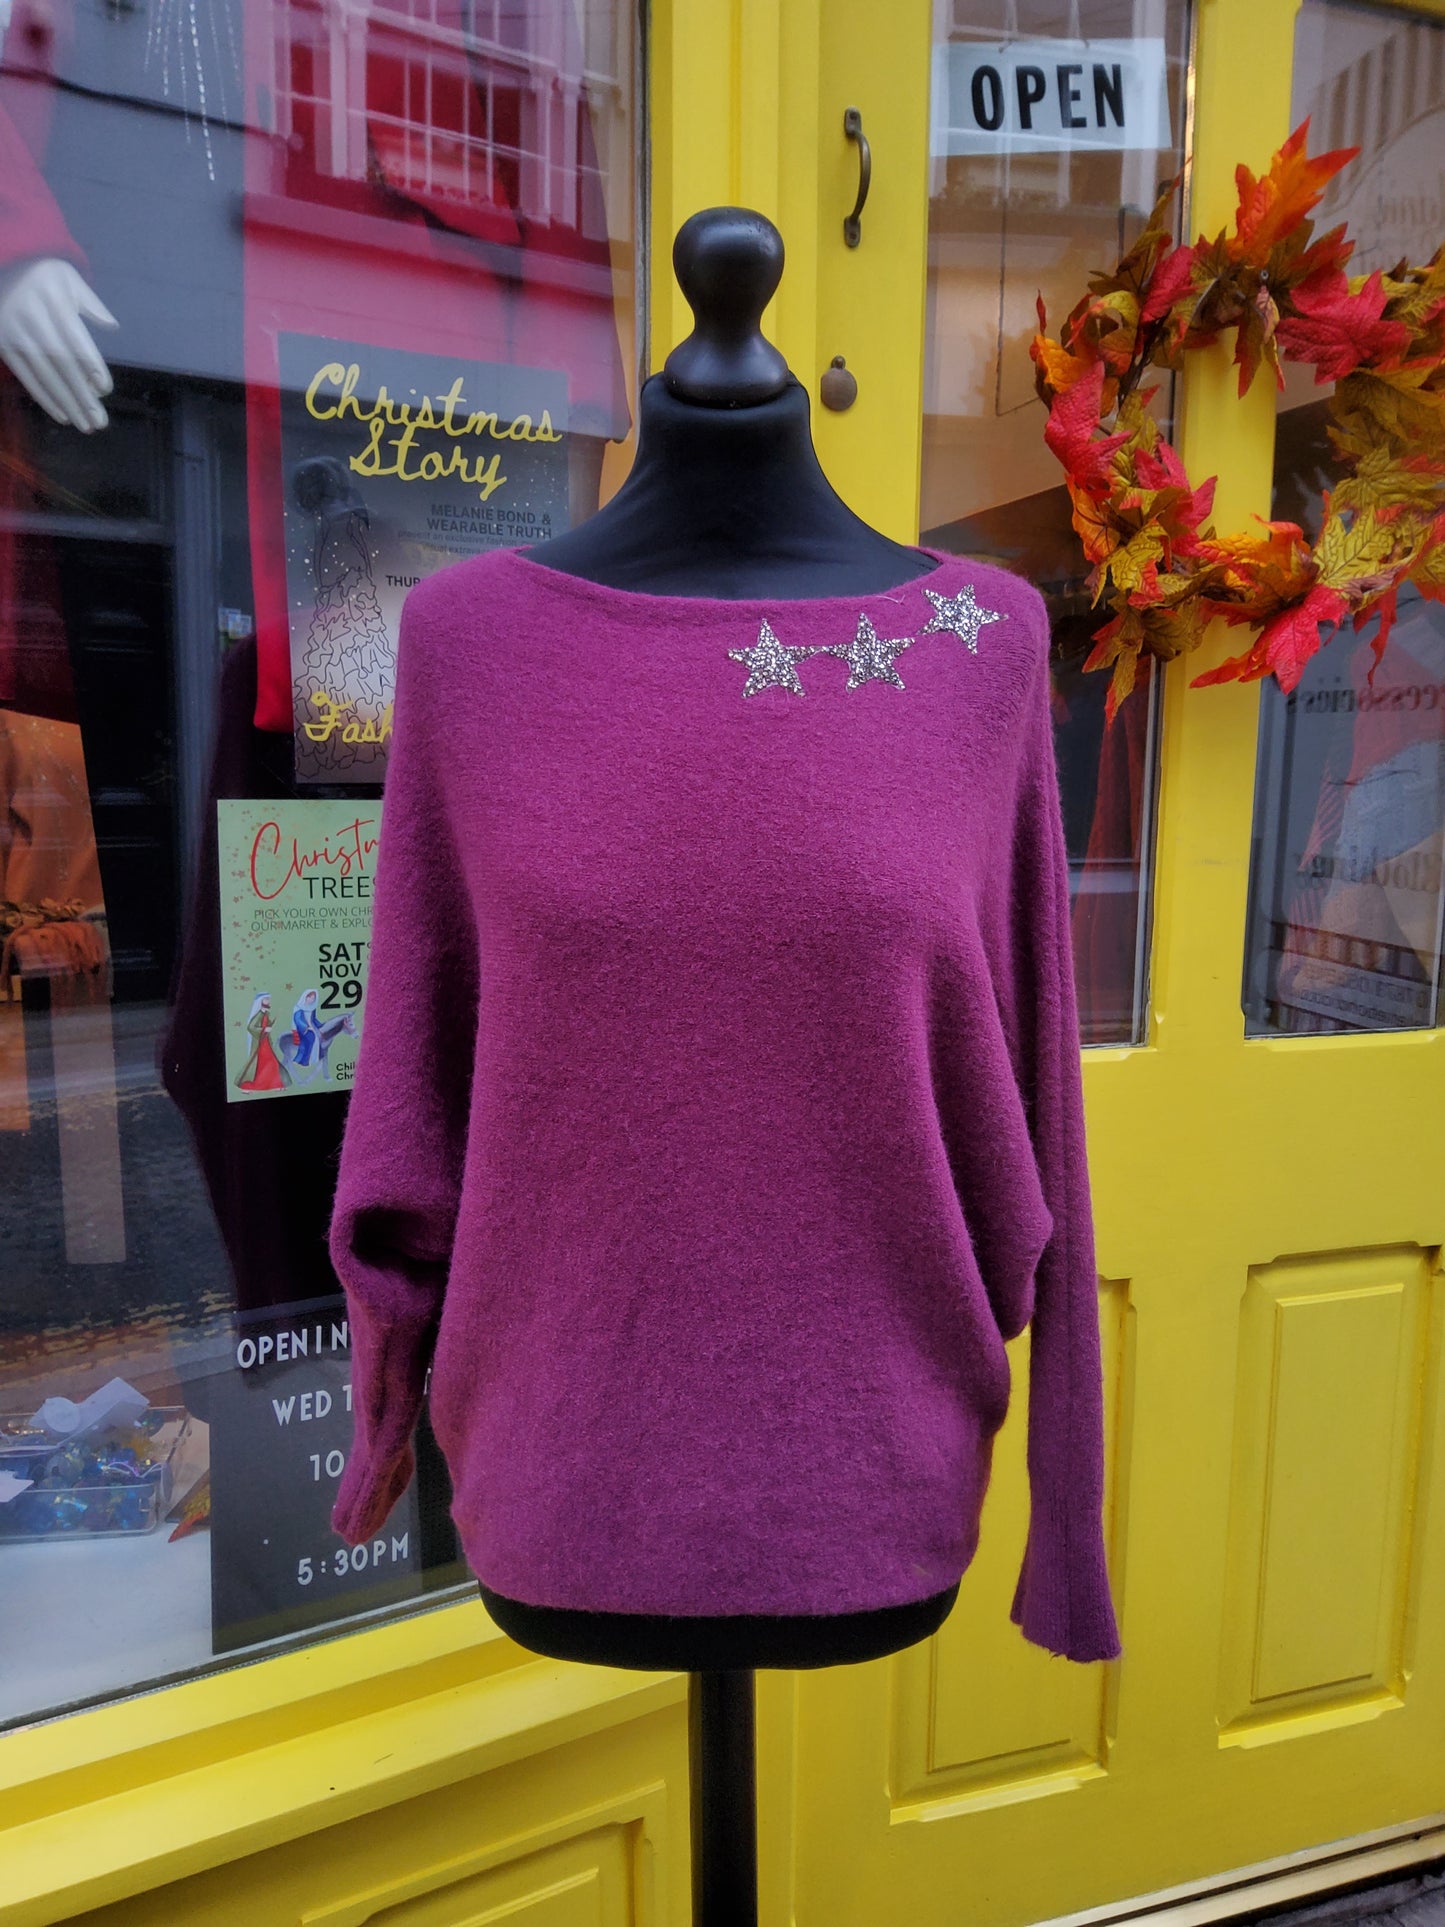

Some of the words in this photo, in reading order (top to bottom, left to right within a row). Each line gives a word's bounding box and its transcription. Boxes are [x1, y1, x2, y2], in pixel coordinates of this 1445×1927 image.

[971, 64, 1125, 131] OPEN
[305, 362, 563, 442] Christmas
[349, 417, 508, 501] Story
[427, 518, 504, 537] WEARABLE
[507, 525, 552, 539] TRUTH
[431, 504, 493, 521] MELANIE
[497, 510, 536, 524] BOND
[541, 514, 552, 526] &
[251, 920, 278, 932] OUR
[280, 918, 327, 931] MARKET
[330, 919, 339, 929] &
[254, 908, 280, 920] PICK
[283, 907, 316, 919] YOUR
[318, 906, 348, 918] OWN
[318, 942, 366, 962] SAT
[319, 963, 362, 979] NOV
[320, 980, 363, 1010] 29
[236, 1321, 348, 1369] OPENIN
[272, 1389, 333, 1427] WED
[309, 1450, 346, 1481] 10
[296, 1532, 409, 1586] 5:30PM
